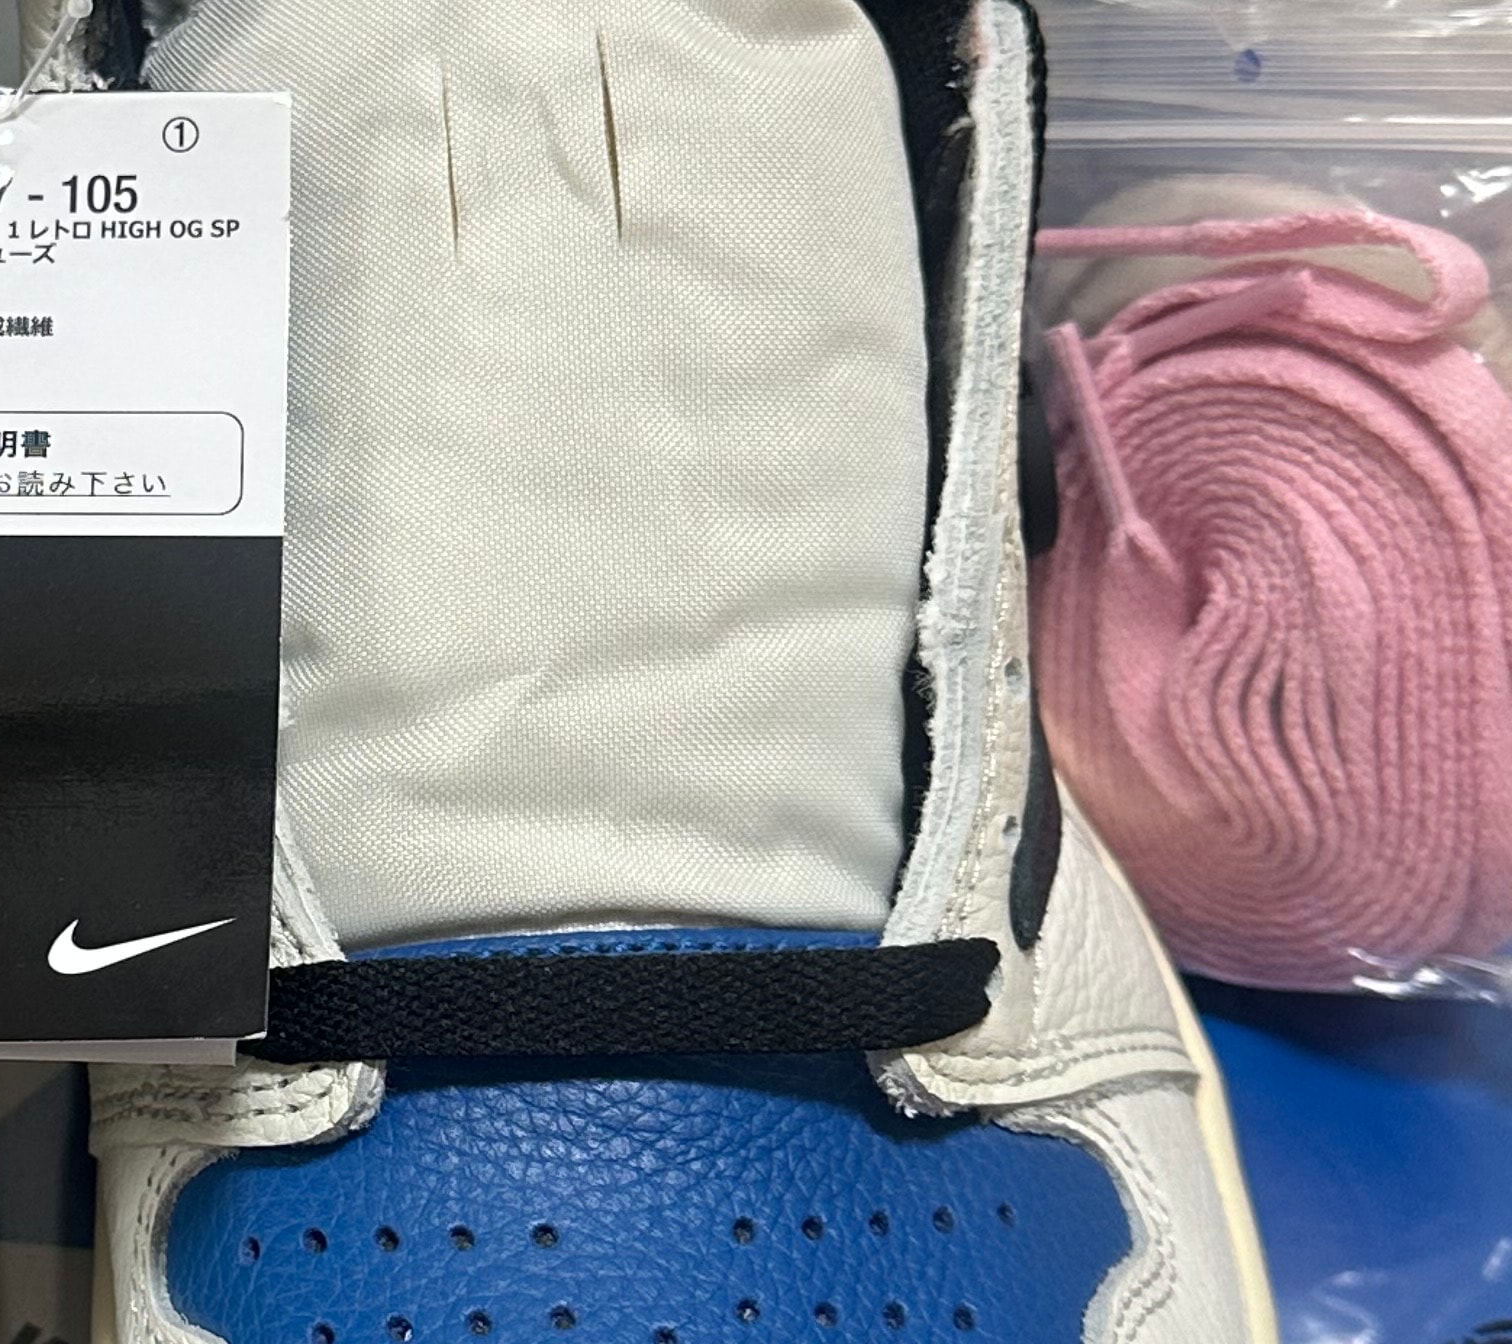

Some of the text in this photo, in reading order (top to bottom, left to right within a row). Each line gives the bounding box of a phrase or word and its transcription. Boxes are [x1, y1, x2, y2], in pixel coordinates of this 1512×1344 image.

[61, 174, 138, 214] 105
[100, 220, 162, 239] HIGH
[169, 219, 203, 239] OG
[209, 219, 240, 239] SP
